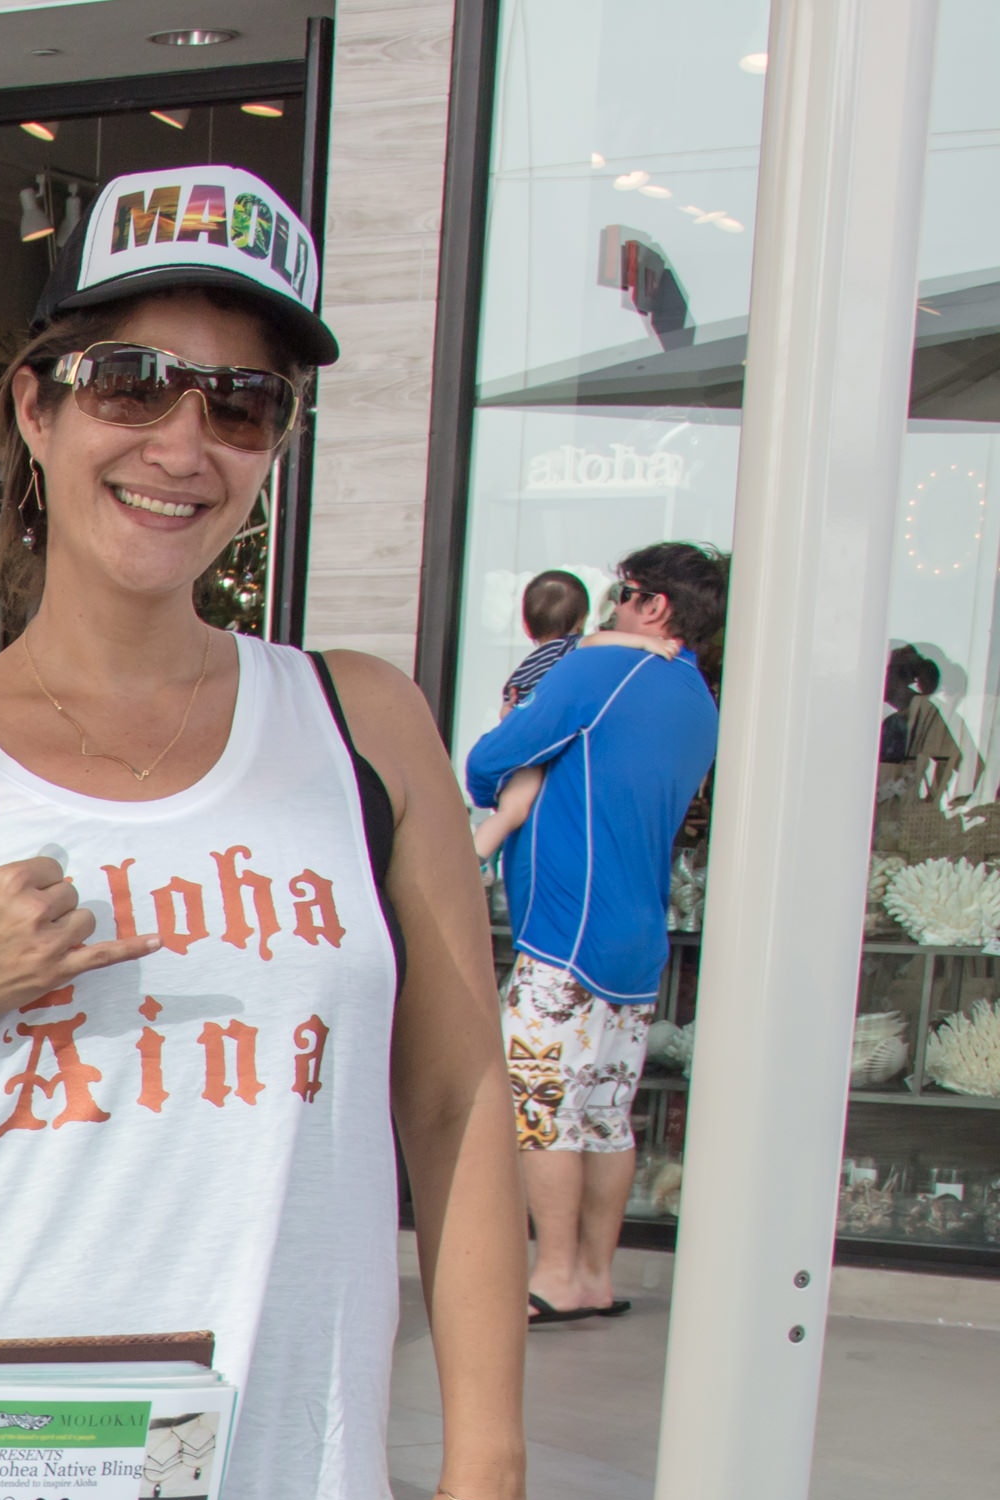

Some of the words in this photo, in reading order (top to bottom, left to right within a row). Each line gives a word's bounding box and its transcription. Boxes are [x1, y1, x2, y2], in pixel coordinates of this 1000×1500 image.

[529, 443, 682, 485] aloha
[64, 845, 346, 961] loha
[60, 1414, 144, 1427] MOLOKAI
[45, 1462, 96, 1477] Native
[102, 1459, 143, 1478] Bling
